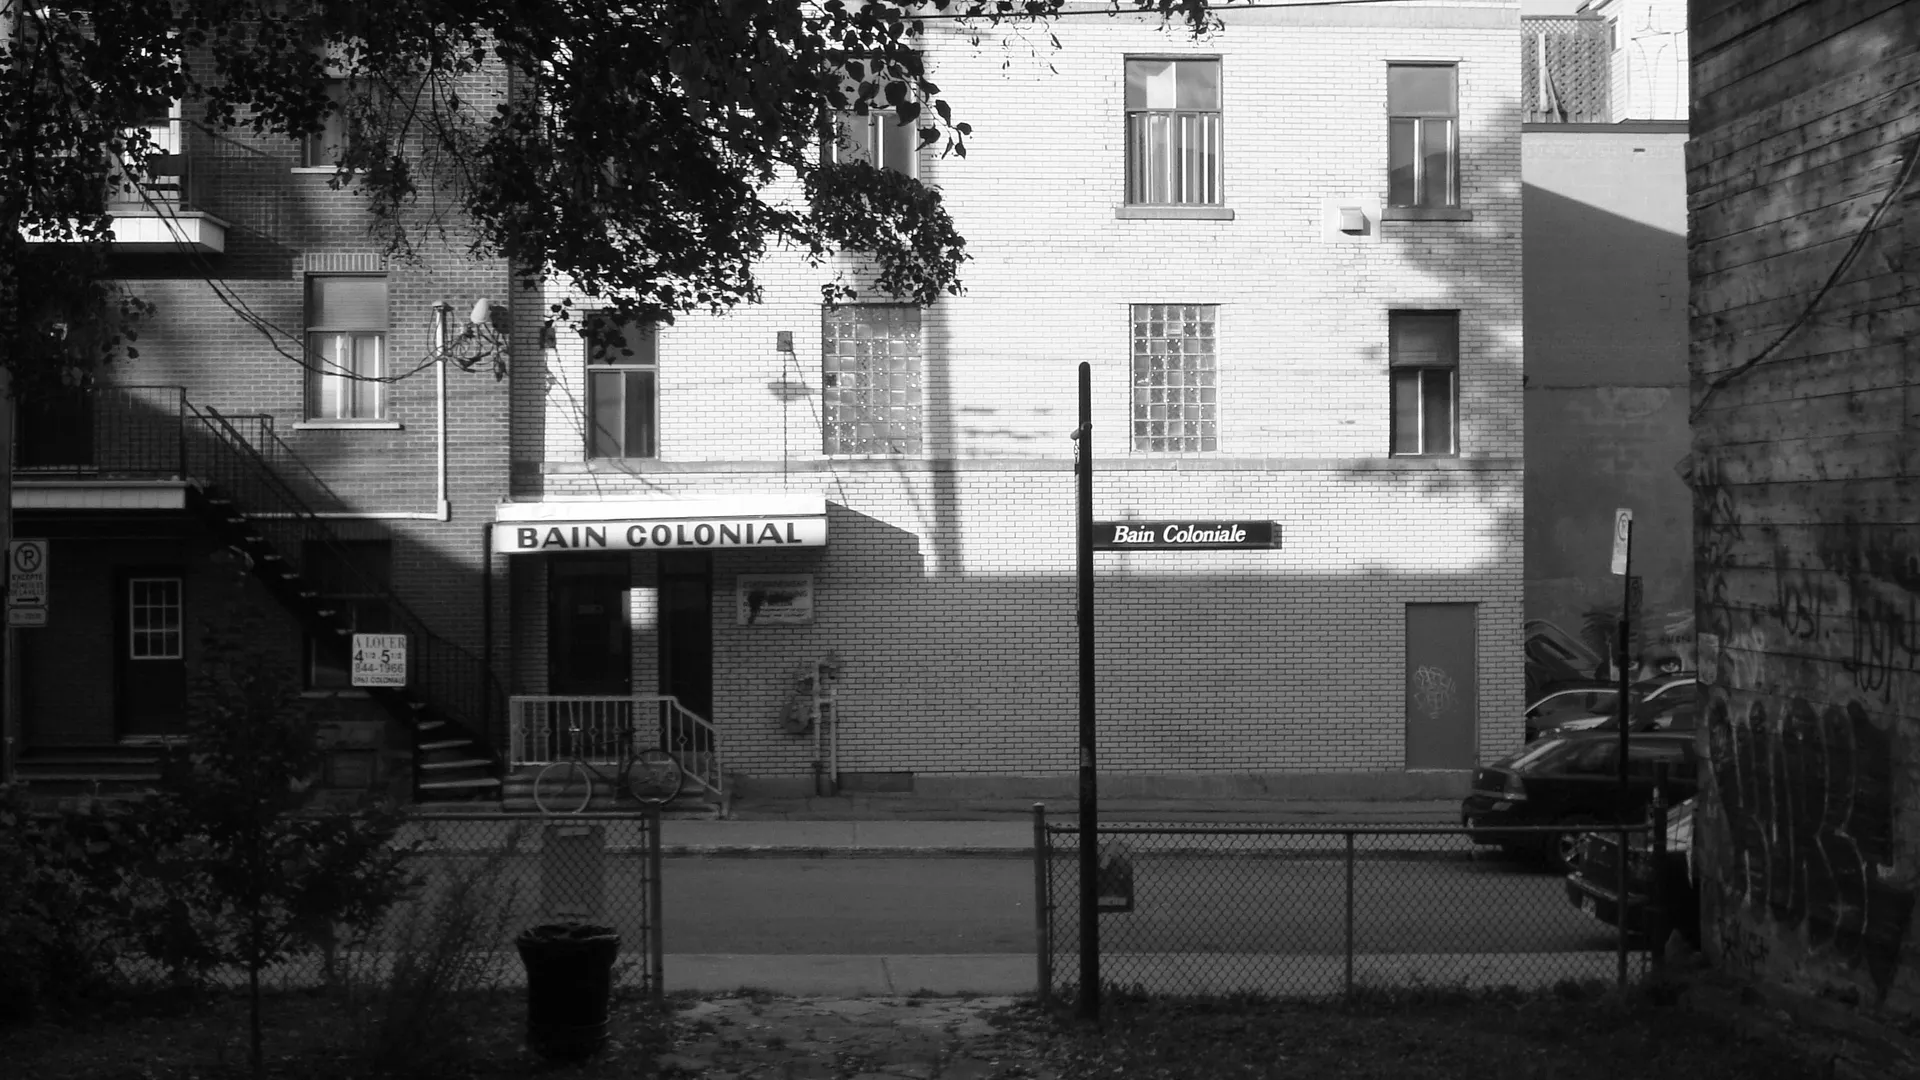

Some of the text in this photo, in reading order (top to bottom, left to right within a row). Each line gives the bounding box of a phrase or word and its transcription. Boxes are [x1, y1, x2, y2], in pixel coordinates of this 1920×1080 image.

[517, 522, 803, 549] BAIN COLONIAL
[1112, 524, 1247, 543] Bain Coloniale
[365, 636, 405, 648] LOUER
[355, 662, 404, 673] 844-1966
